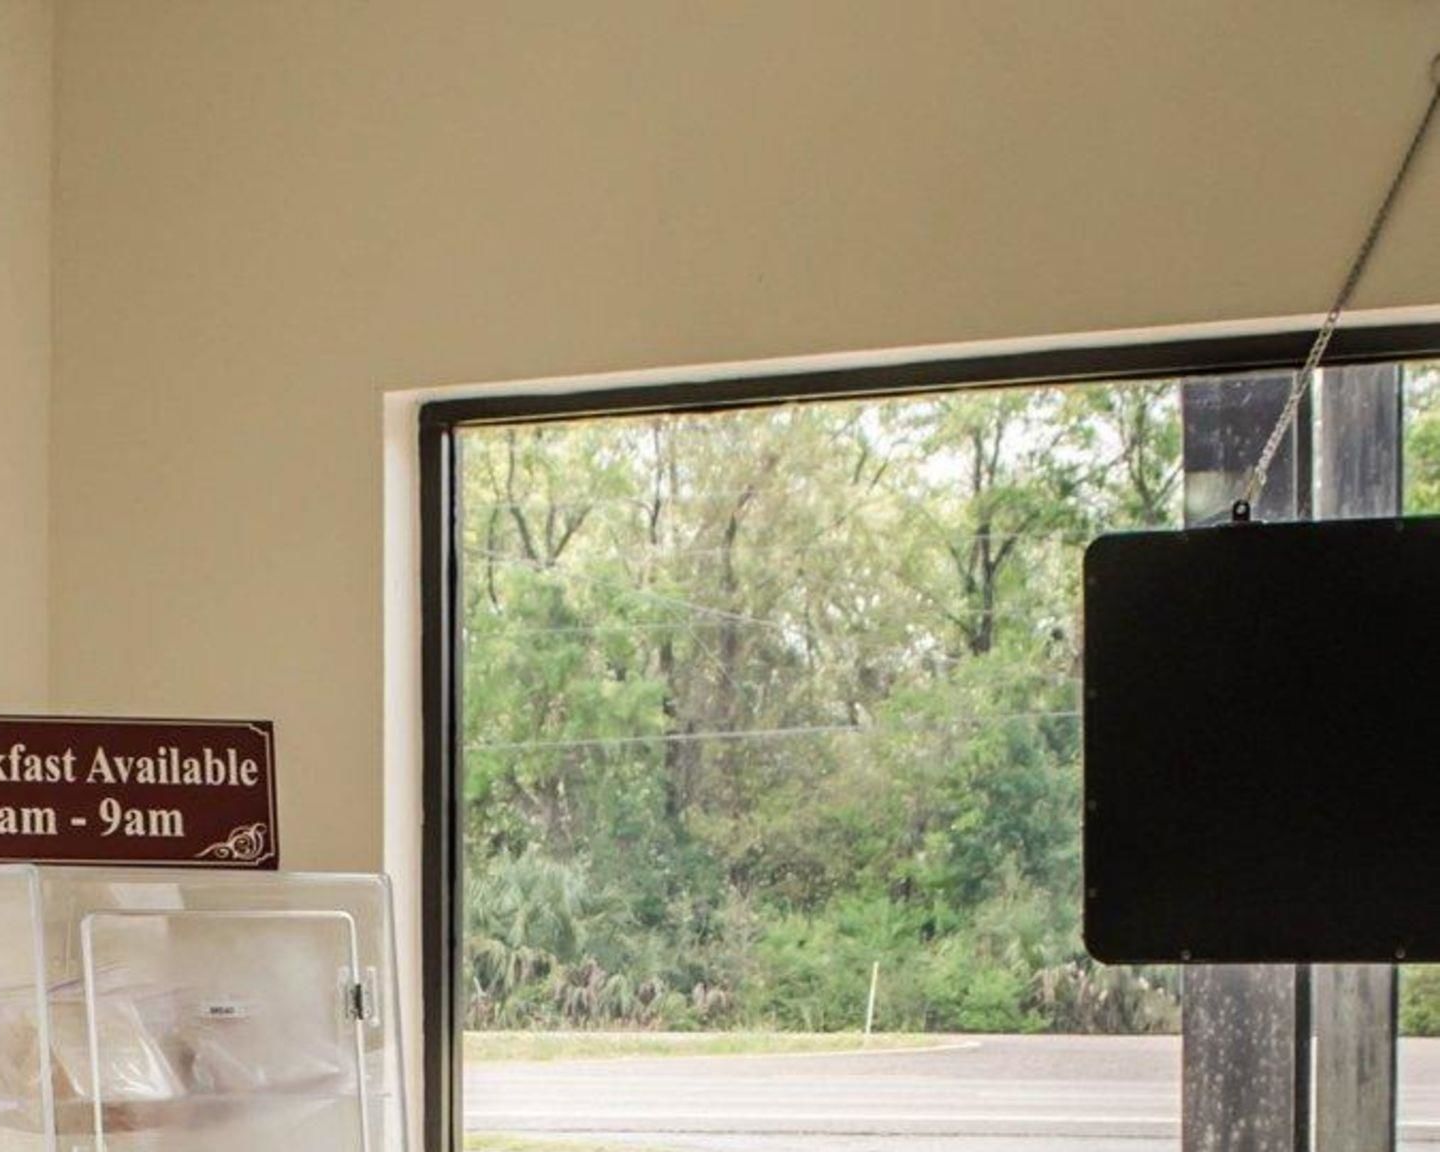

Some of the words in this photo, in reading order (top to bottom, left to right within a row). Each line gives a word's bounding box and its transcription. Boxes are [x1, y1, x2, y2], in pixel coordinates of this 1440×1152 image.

[86, 746, 259, 786] Available
[70, 816, 86, 827] -
[99, 798, 185, 837] 9am
